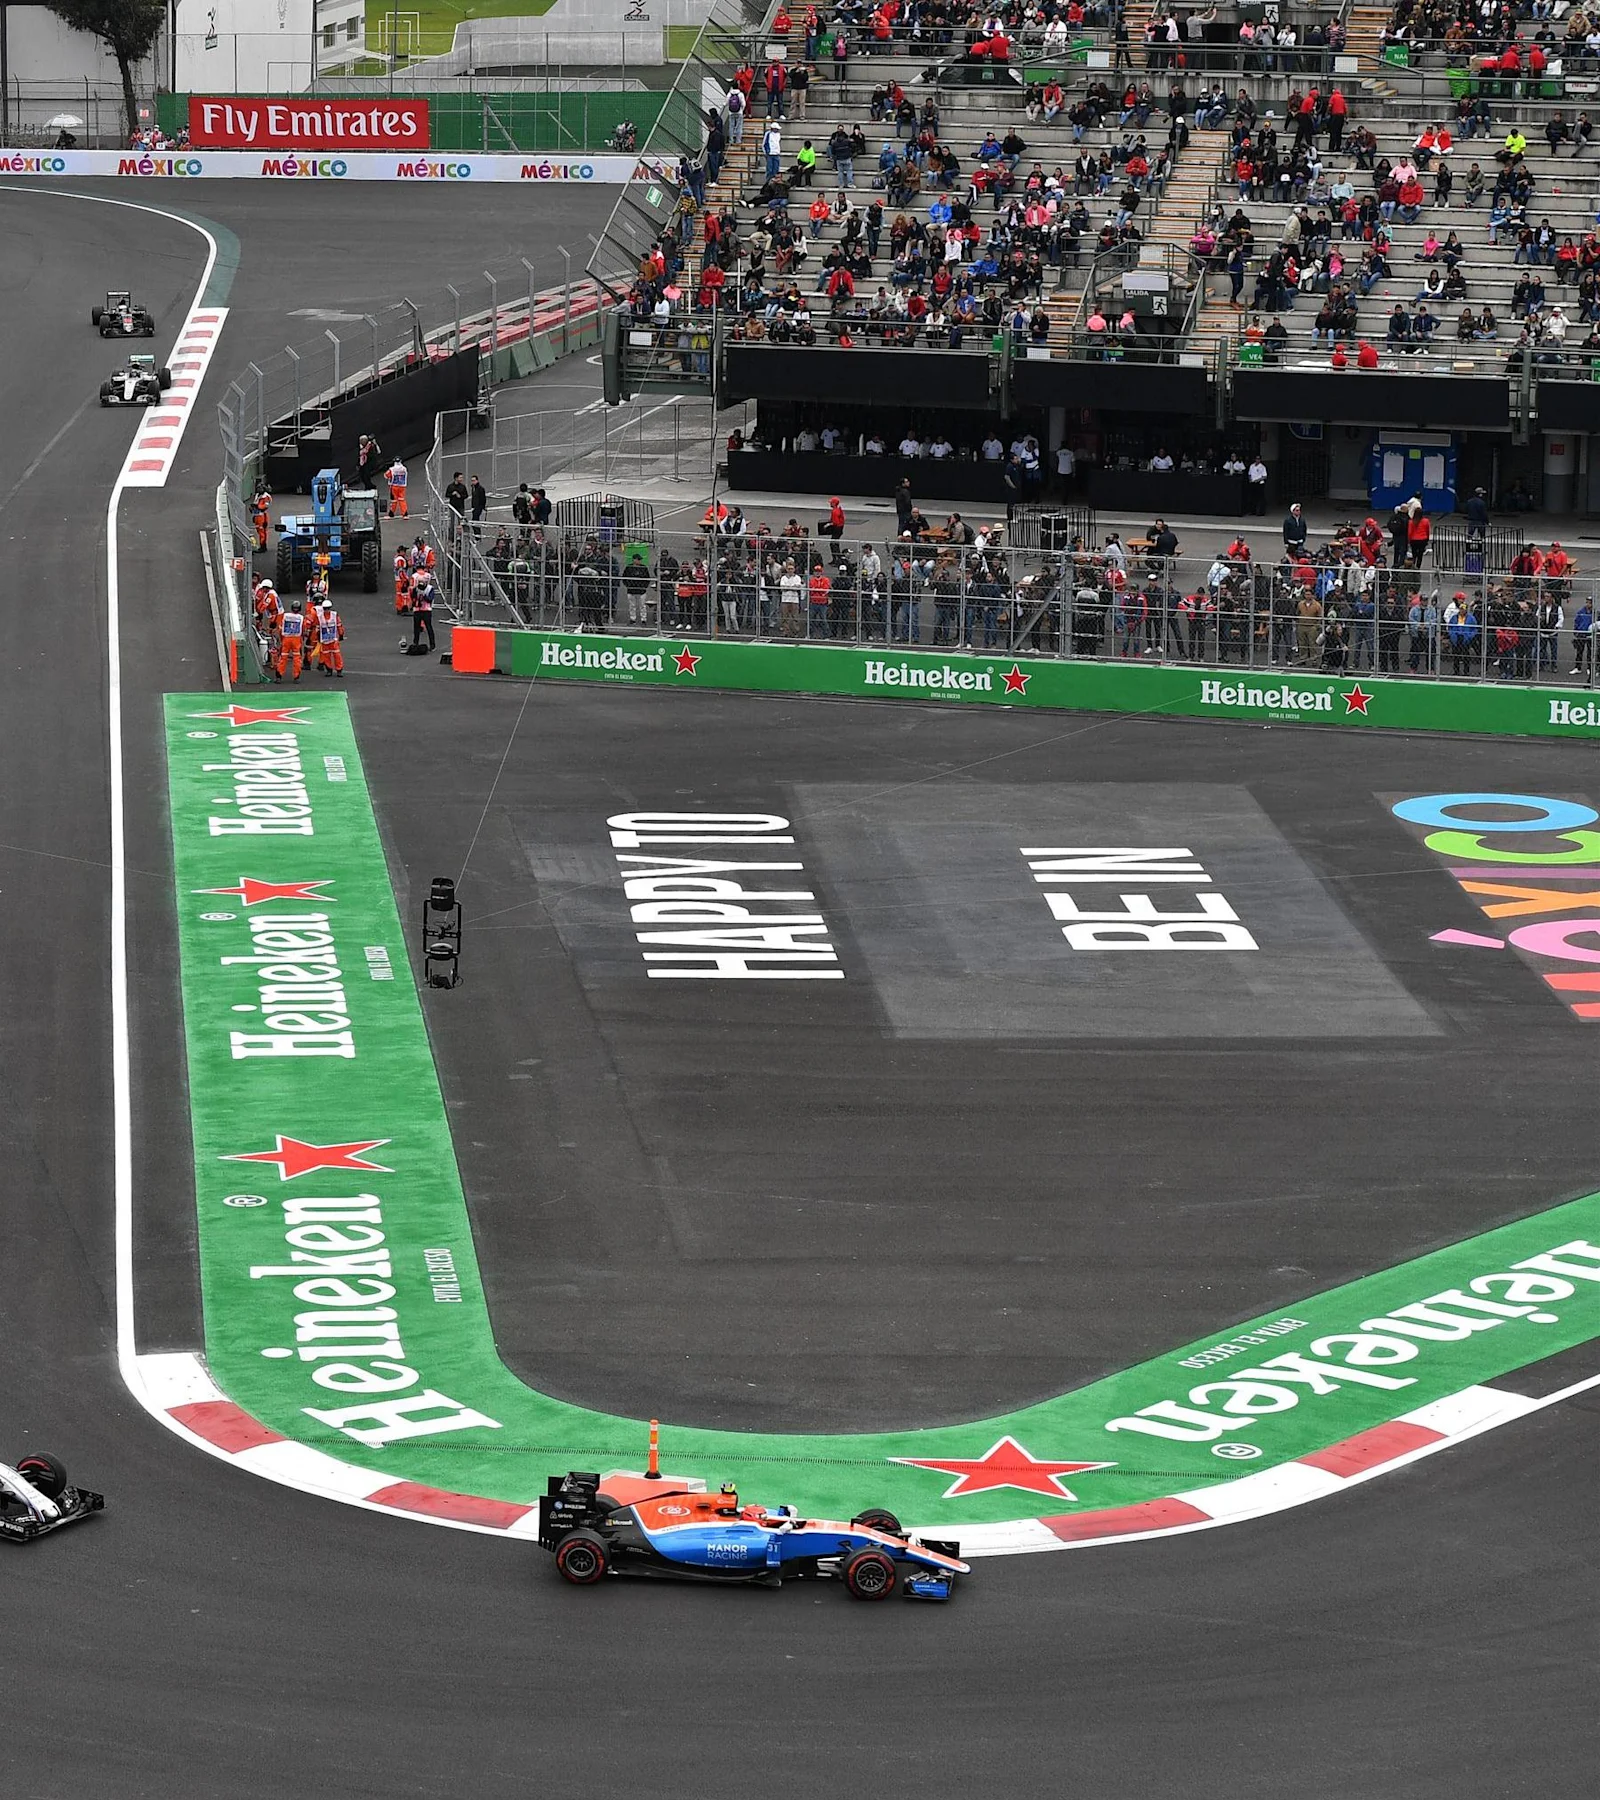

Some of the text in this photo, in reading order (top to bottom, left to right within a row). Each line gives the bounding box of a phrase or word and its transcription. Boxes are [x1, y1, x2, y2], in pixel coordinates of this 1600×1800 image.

[201, 103, 418, 141] Fly Emirates
[541, 642, 663, 672] Heineken
[864, 661, 992, 691] Heineken
[1200, 680, 1333, 711] Heineken
[1548, 700, 1600, 726] Hei
[202, 732, 314, 836] Heineken
[607, 813, 794, 847] TO
[1020, 848, 1212, 882] IN
[616, 855, 844, 978] HAPPY
[1043, 893, 1259, 950] BE
[220, 912, 356, 1060] Heineken
[423, 1248, 463, 1303] EVITA EL EXCESO
[249, 1193, 504, 1448] Heineken
[1177, 1317, 1309, 1369] EVITA EL EXCESO
[707, 1543, 748, 1553] MANOR
[707, 1553, 748, 1561] RACING
[767, 1543, 779, 1553] 31
